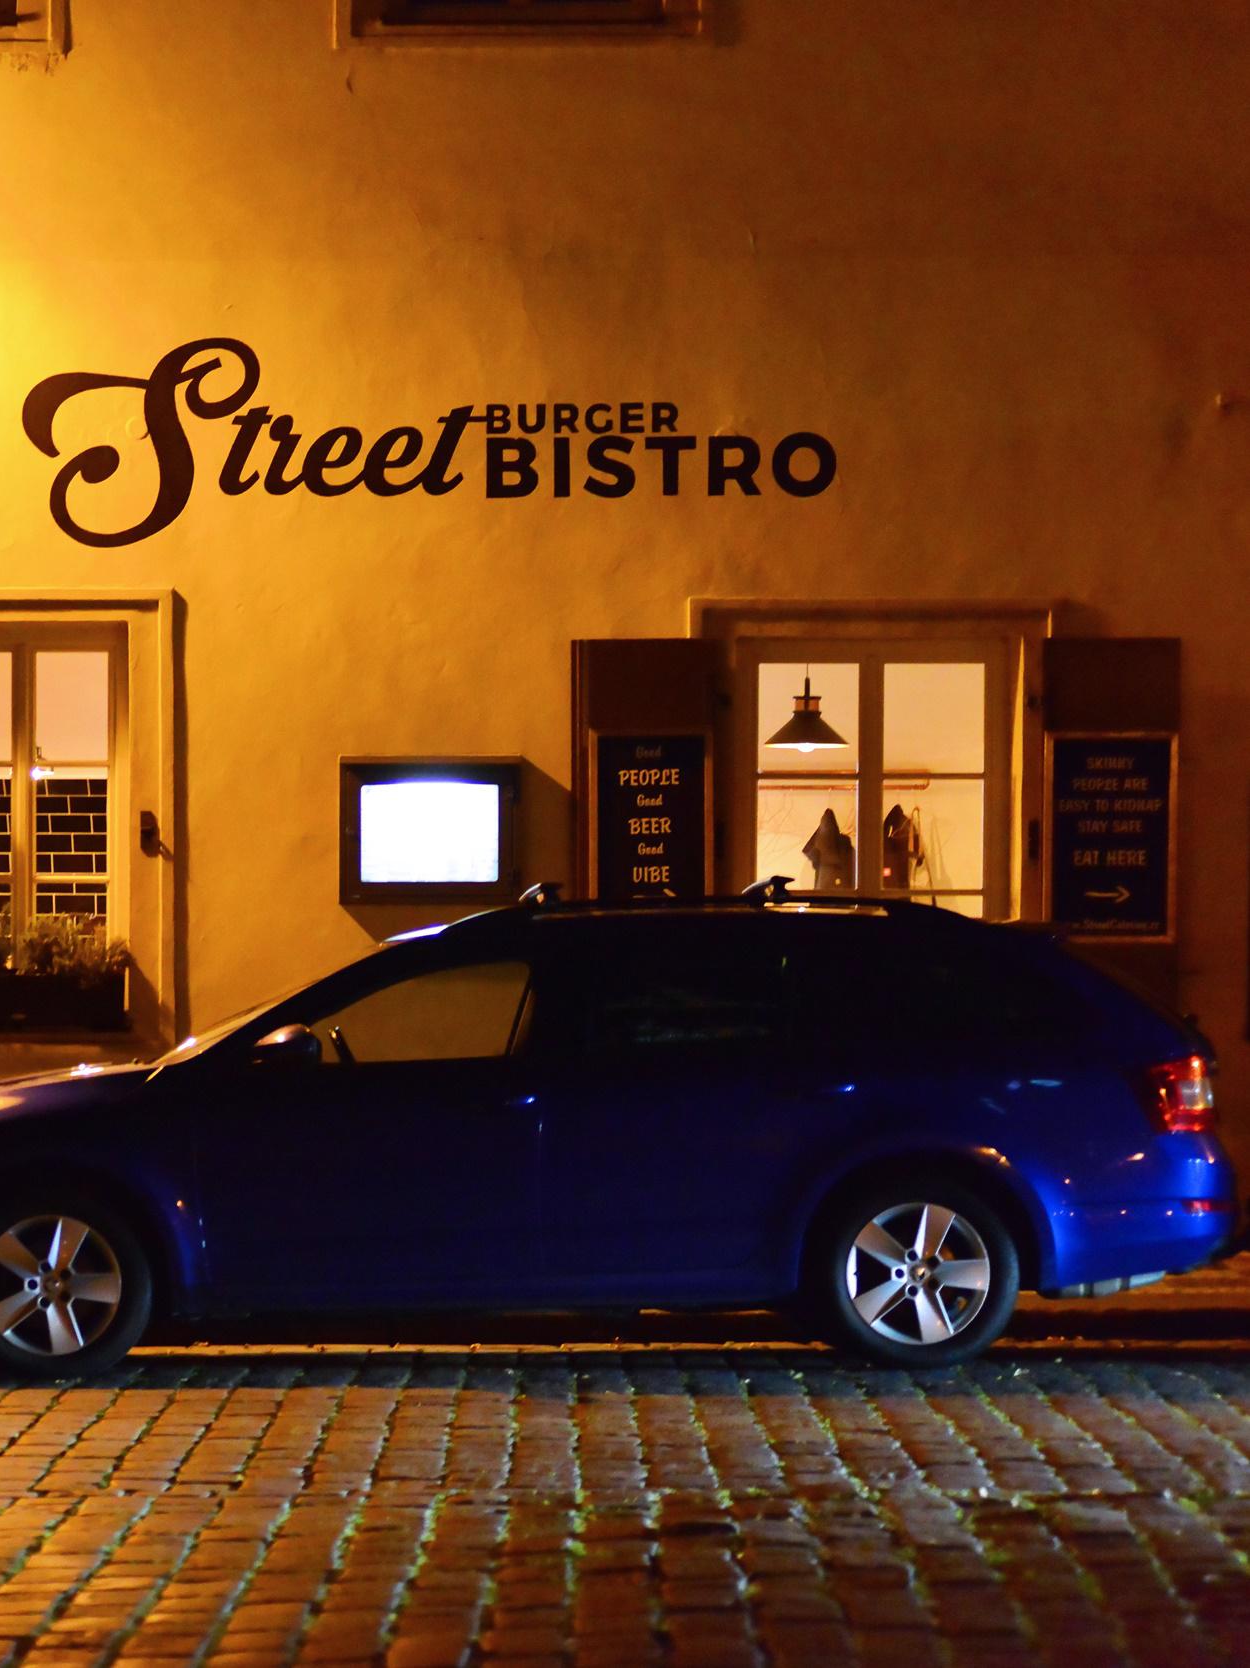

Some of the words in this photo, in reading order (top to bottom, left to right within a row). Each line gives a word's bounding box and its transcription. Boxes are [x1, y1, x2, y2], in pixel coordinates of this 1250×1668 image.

[486, 401, 680, 435] BURGER
[21, 336, 494, 549] Street
[486, 431, 838, 499] BISTRO
[1086, 755, 1134, 771] SKINNY
[618, 768, 681, 787] PEOPLE
[1072, 777, 1119, 792] PEOPLE
[1122, 776, 1150, 791] ARE
[636, 792, 663, 807] Good
[1094, 799, 1109, 813] TO
[628, 816, 671, 835] BEER
[1077, 819, 1109, 833] STAY
[1113, 819, 1143, 833] SAFE
[637, 842, 664, 856] Good
[1073, 849, 1101, 866] EAT
[1106, 848, 1149, 866] HERE
